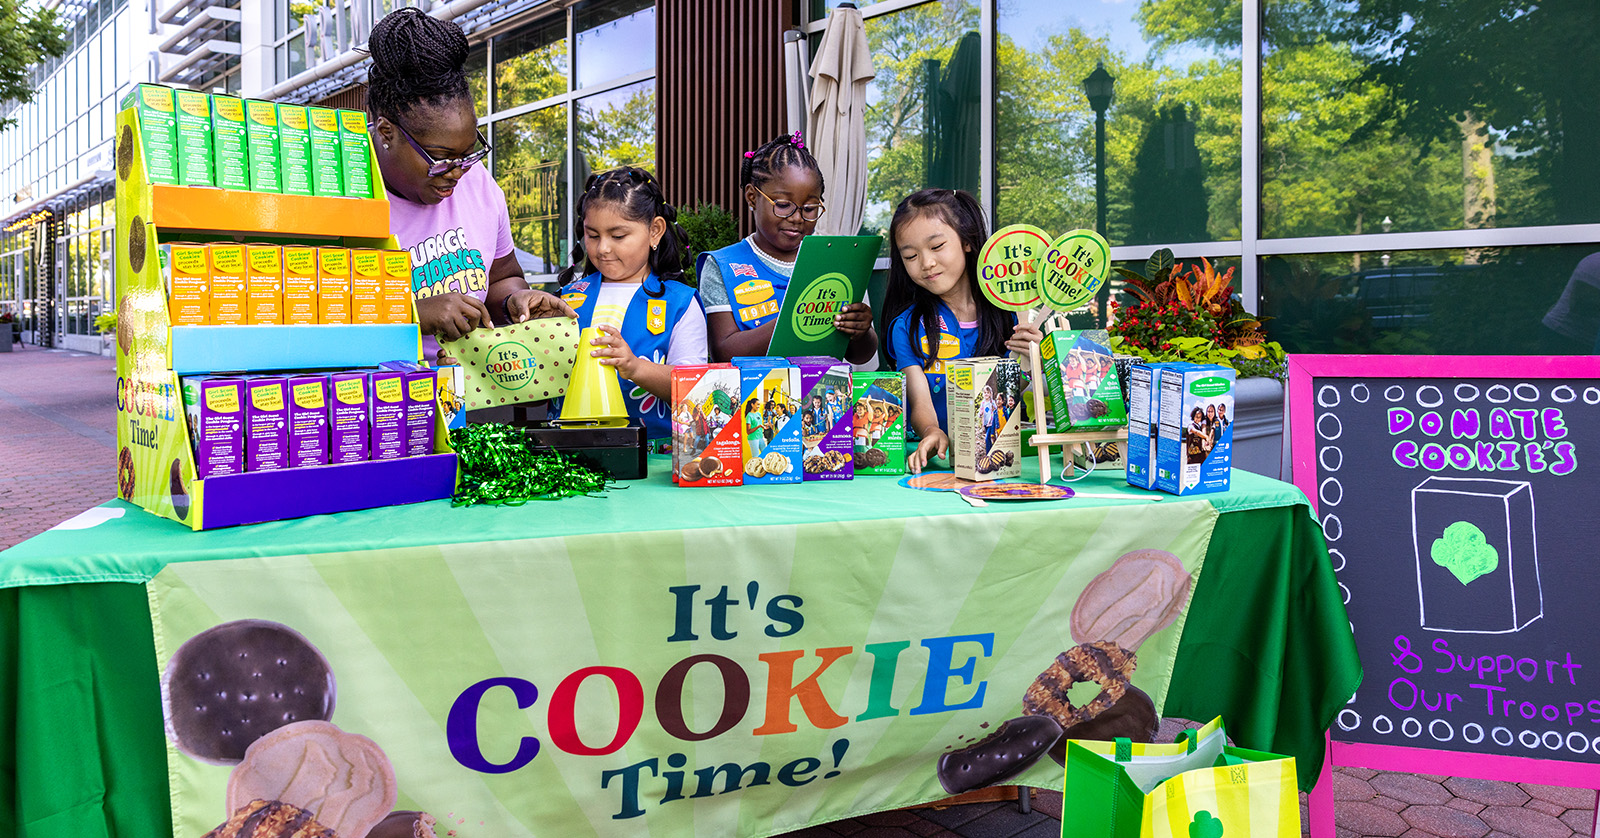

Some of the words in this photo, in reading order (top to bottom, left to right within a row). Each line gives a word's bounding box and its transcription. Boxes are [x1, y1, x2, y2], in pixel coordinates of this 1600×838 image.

[402, 227, 468, 268] URAGE
[1004, 244, 1032, 259] It's
[1072, 245, 1094, 268] It's
[411, 249, 486, 292] FIDENCE
[412, 268, 486, 300] RACTER
[982, 258, 1041, 280] COOK
[1047, 249, 1100, 293] COOKIE
[1048, 269, 1082, 300] Time!
[817, 289, 836, 300] It's
[997, 280, 1037, 294] Time
[743, 302, 777, 319] 1912
[796, 301, 849, 314] COOKIE
[803, 314, 835, 326] Time!
[486, 357, 536, 374] COOKIE
[498, 350, 518, 361] It's
[497, 371, 529, 383] Time!
[117, 377, 174, 421] COOKIE
[130, 419, 158, 450] Time!
[1386, 407, 1568, 441] DONATE
[1392, 440, 1577, 476] COOKIE'S
[666, 580, 805, 642] It's
[1431, 638, 1582, 685] Support
[446, 632, 995, 774] COOKIE
[1388, 676, 1463, 712] Our
[601, 738, 850, 820] Time!
